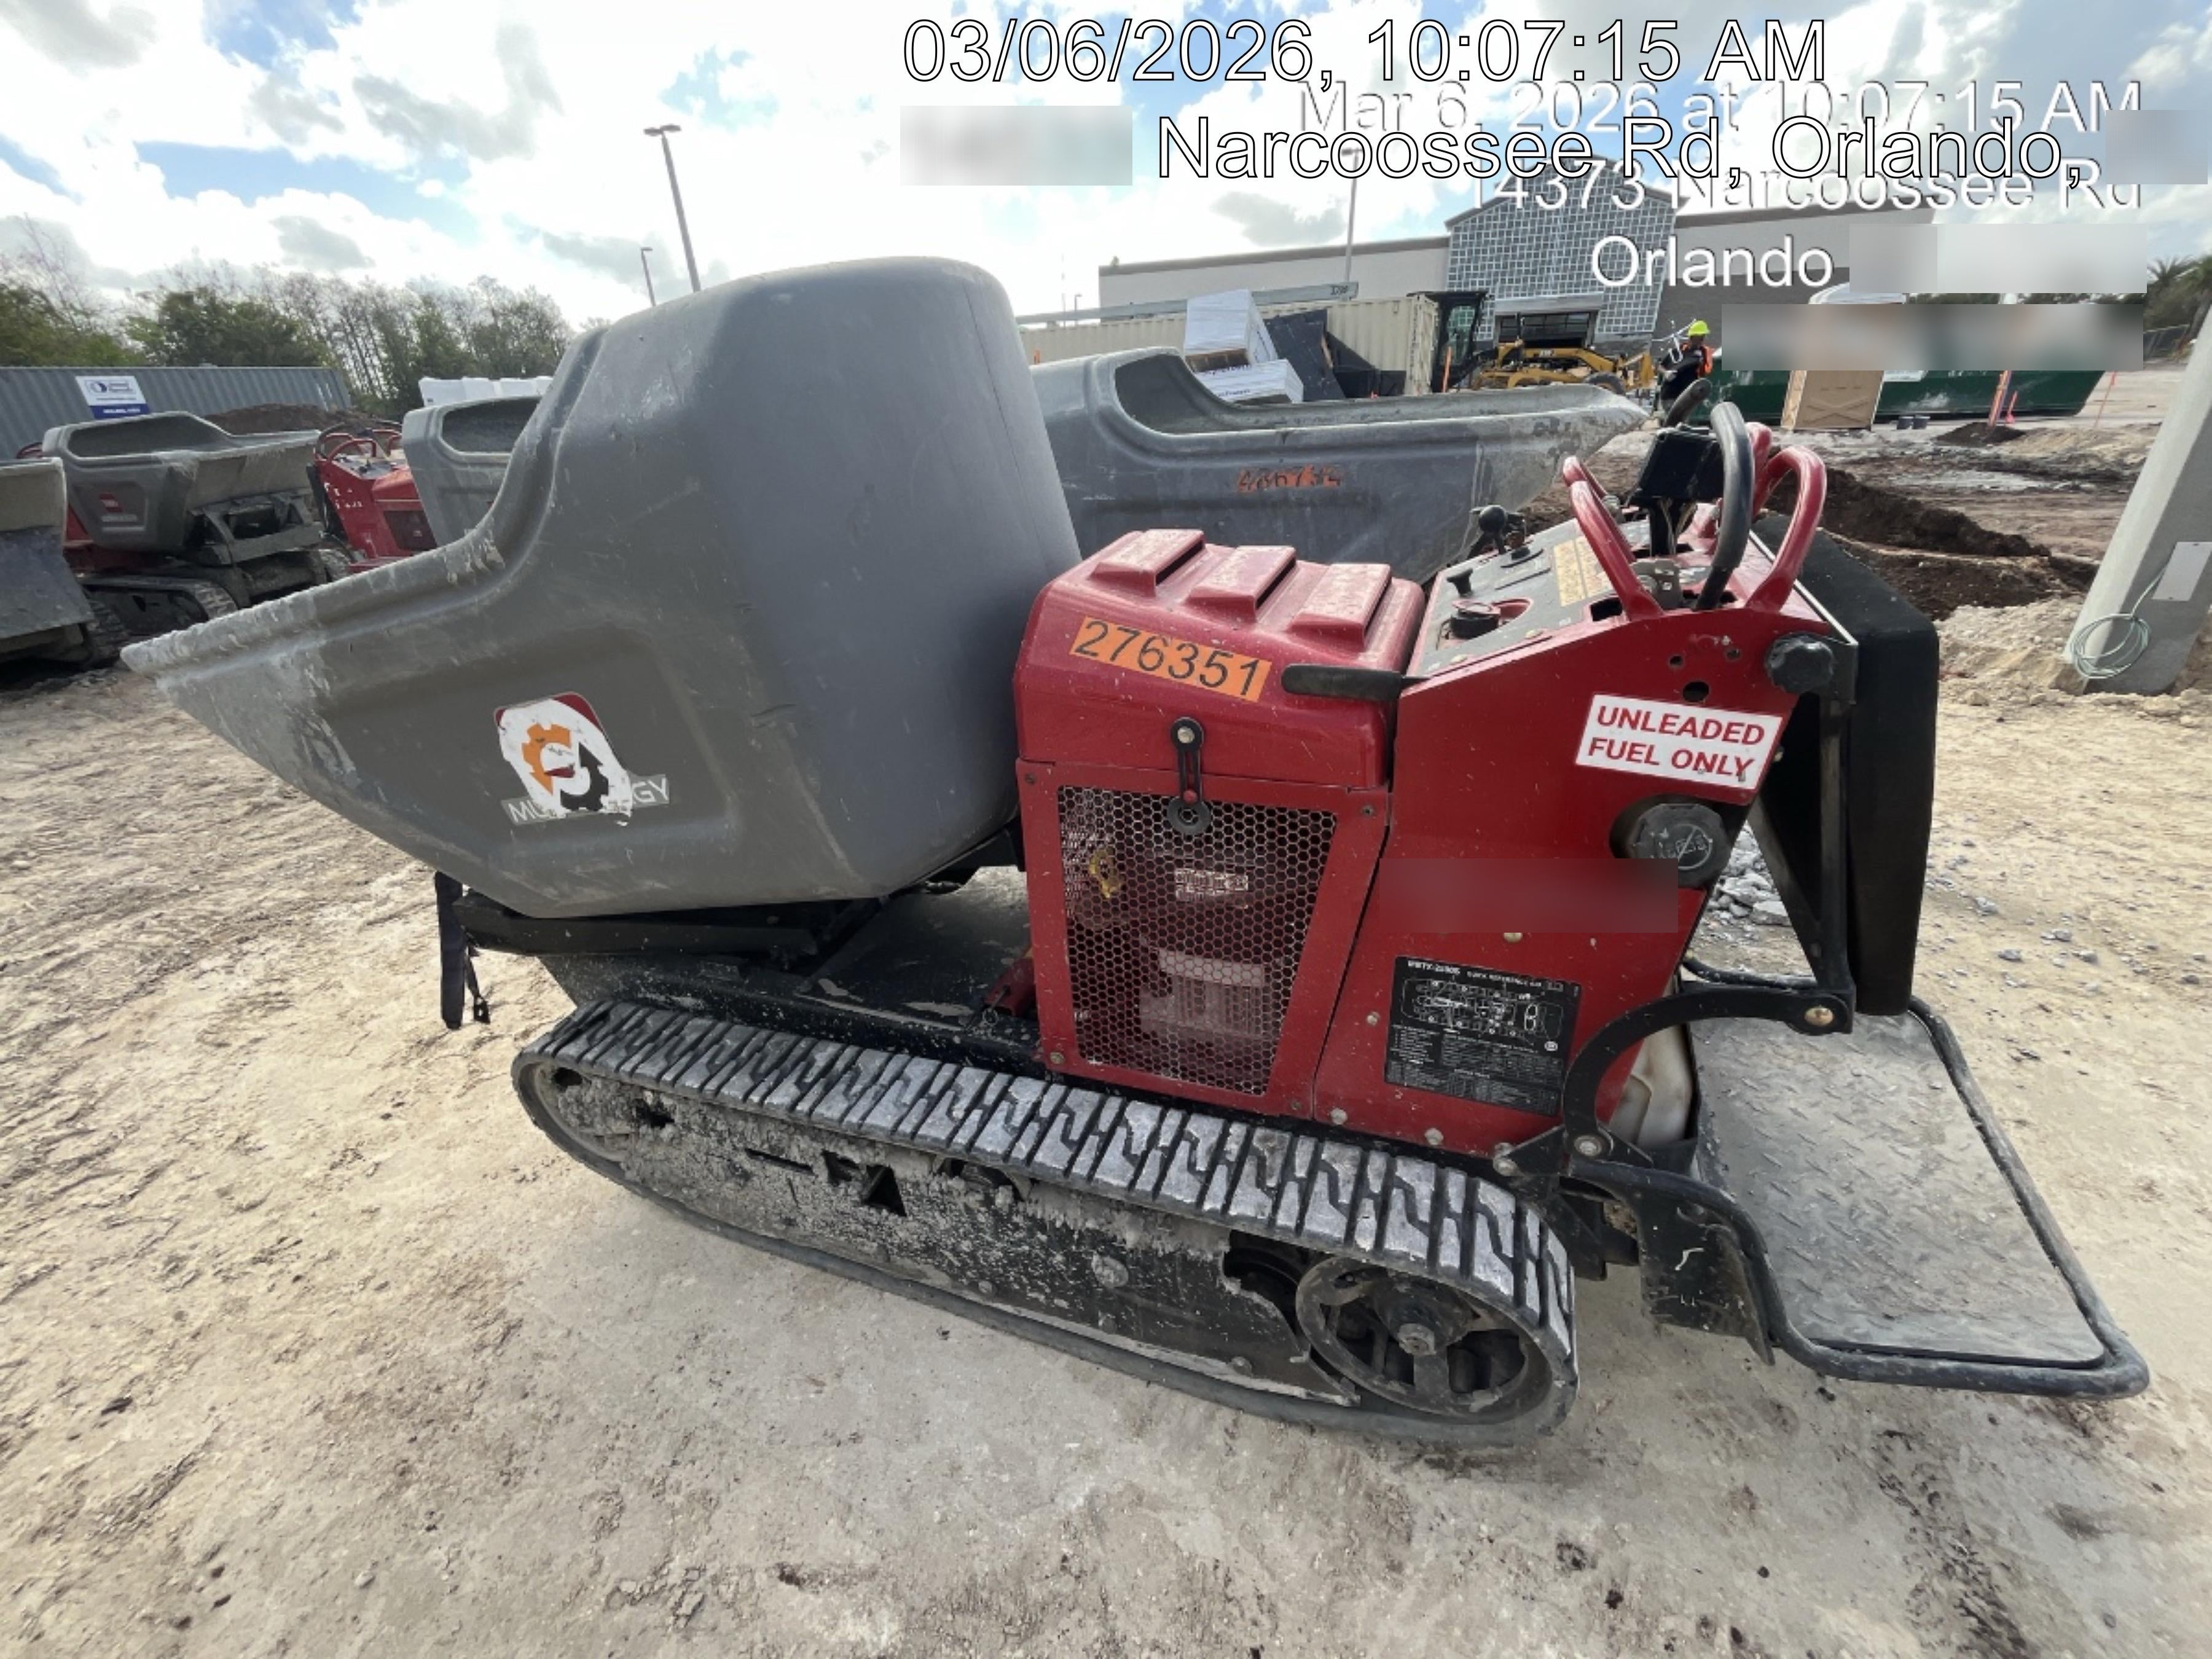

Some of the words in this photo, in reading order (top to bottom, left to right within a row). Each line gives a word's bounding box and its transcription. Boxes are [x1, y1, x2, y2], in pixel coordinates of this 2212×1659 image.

[1074, 620, 1260, 696] 276351
[1596, 705, 1765, 745] UNLEADED
[1588, 737, 1660, 766] FUEL
[1671, 748, 1755, 777] ONLY
